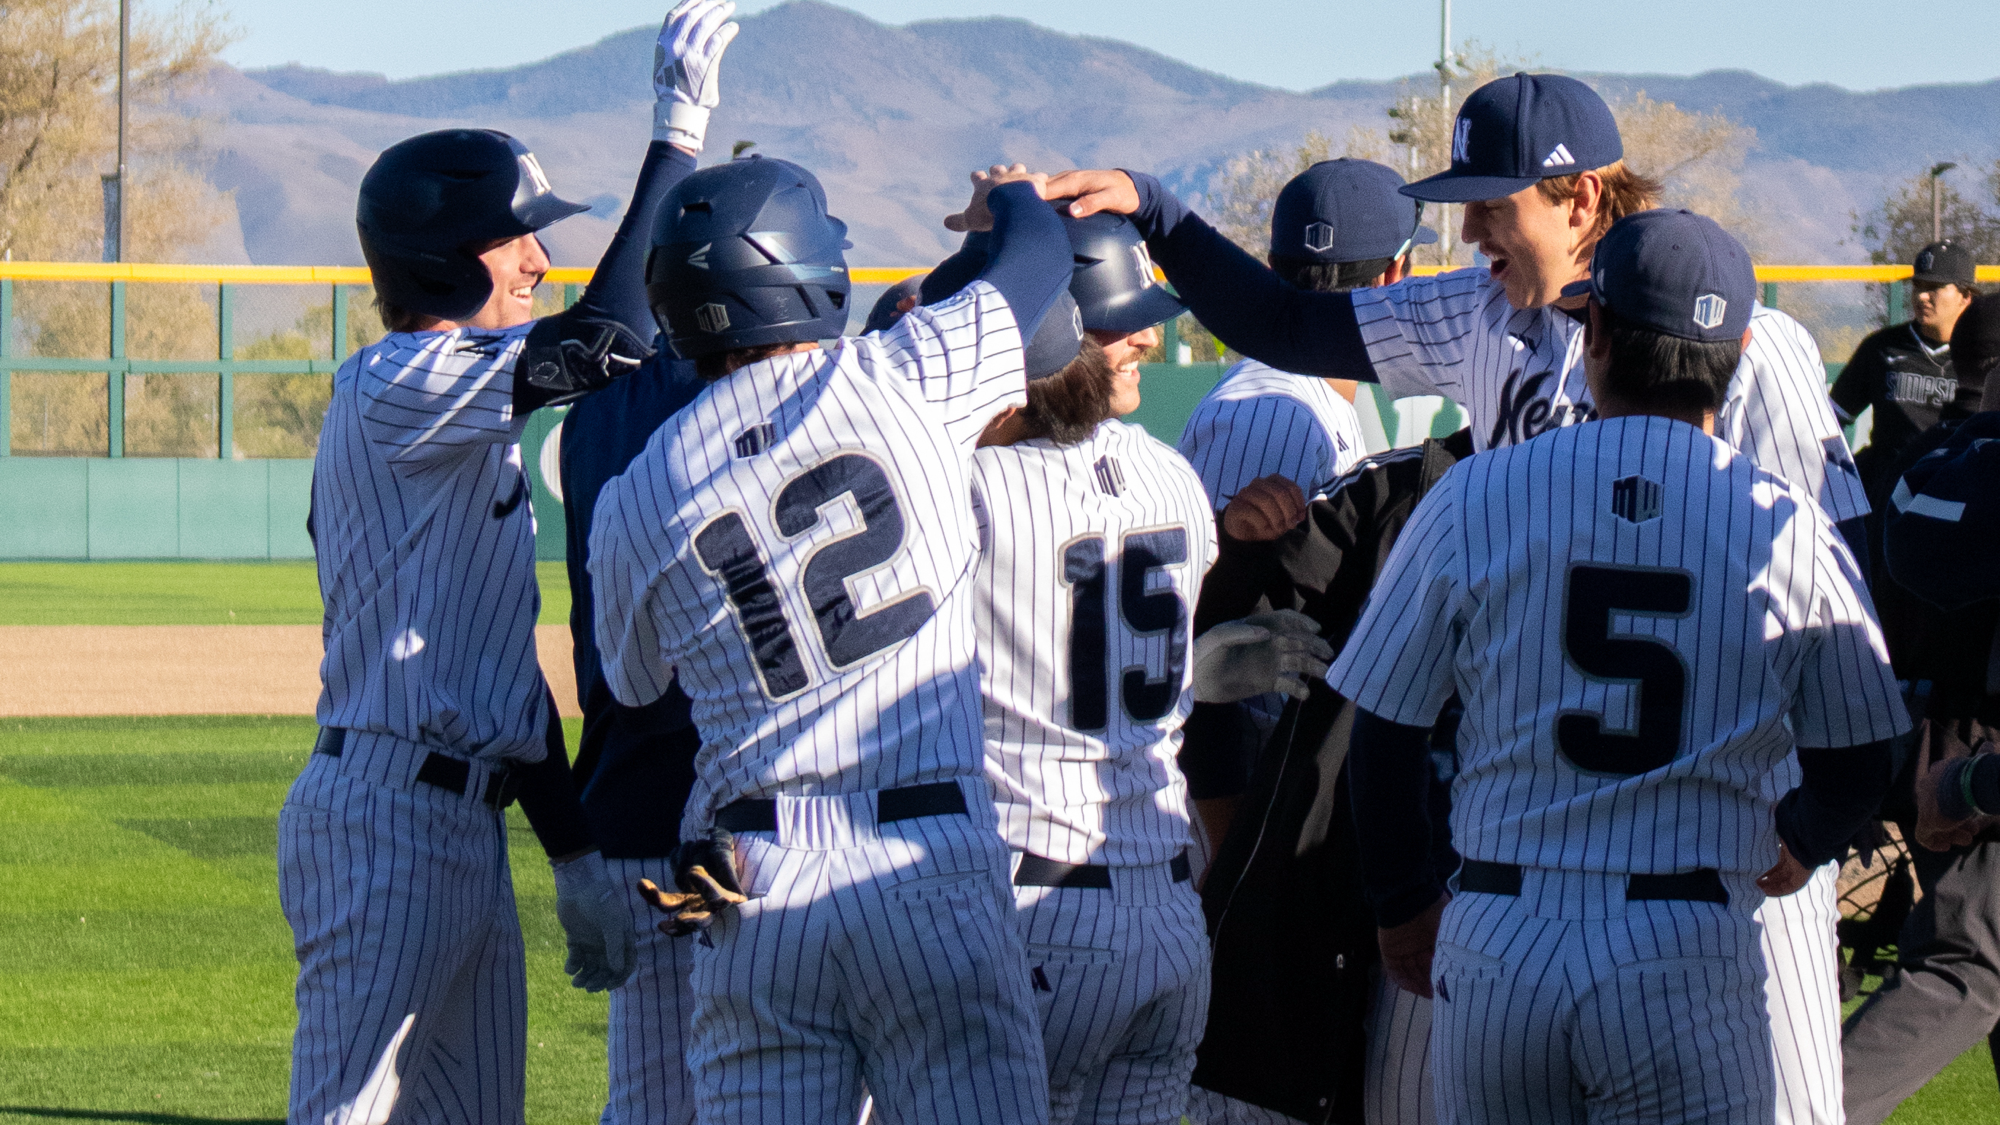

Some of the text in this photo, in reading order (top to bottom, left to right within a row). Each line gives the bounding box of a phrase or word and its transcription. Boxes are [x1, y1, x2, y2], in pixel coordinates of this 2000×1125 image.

[518, 152, 551, 196] N
[1131, 240, 1156, 290] N
[691, 447, 938, 702] 12
[1057, 521, 1190, 732] 15
[1553, 560, 1696, 778] 5
